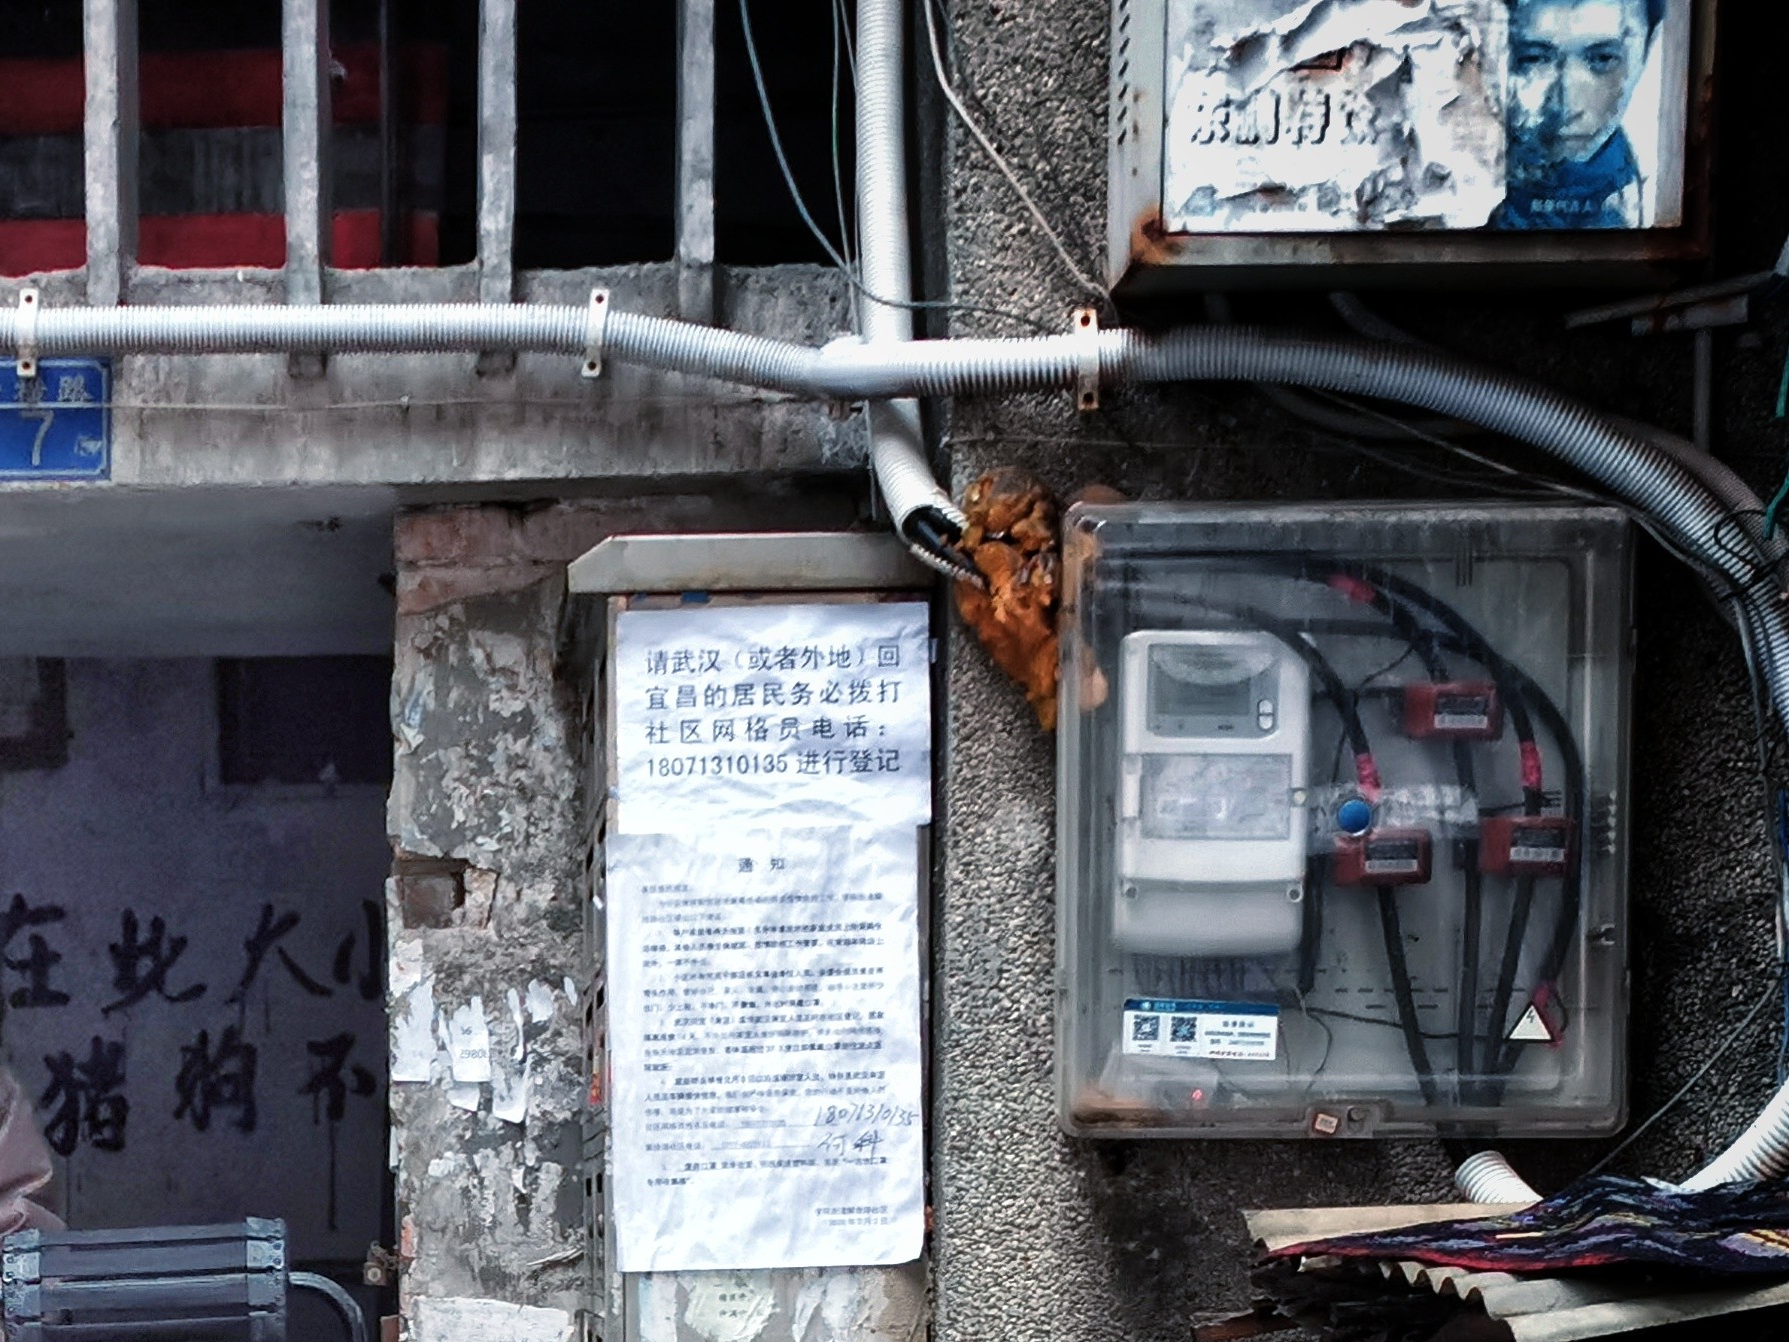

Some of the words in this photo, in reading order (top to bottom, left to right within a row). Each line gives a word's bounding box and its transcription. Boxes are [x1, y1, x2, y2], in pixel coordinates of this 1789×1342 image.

[645, 678, 902, 711] 宜昌的居民务必拨打
